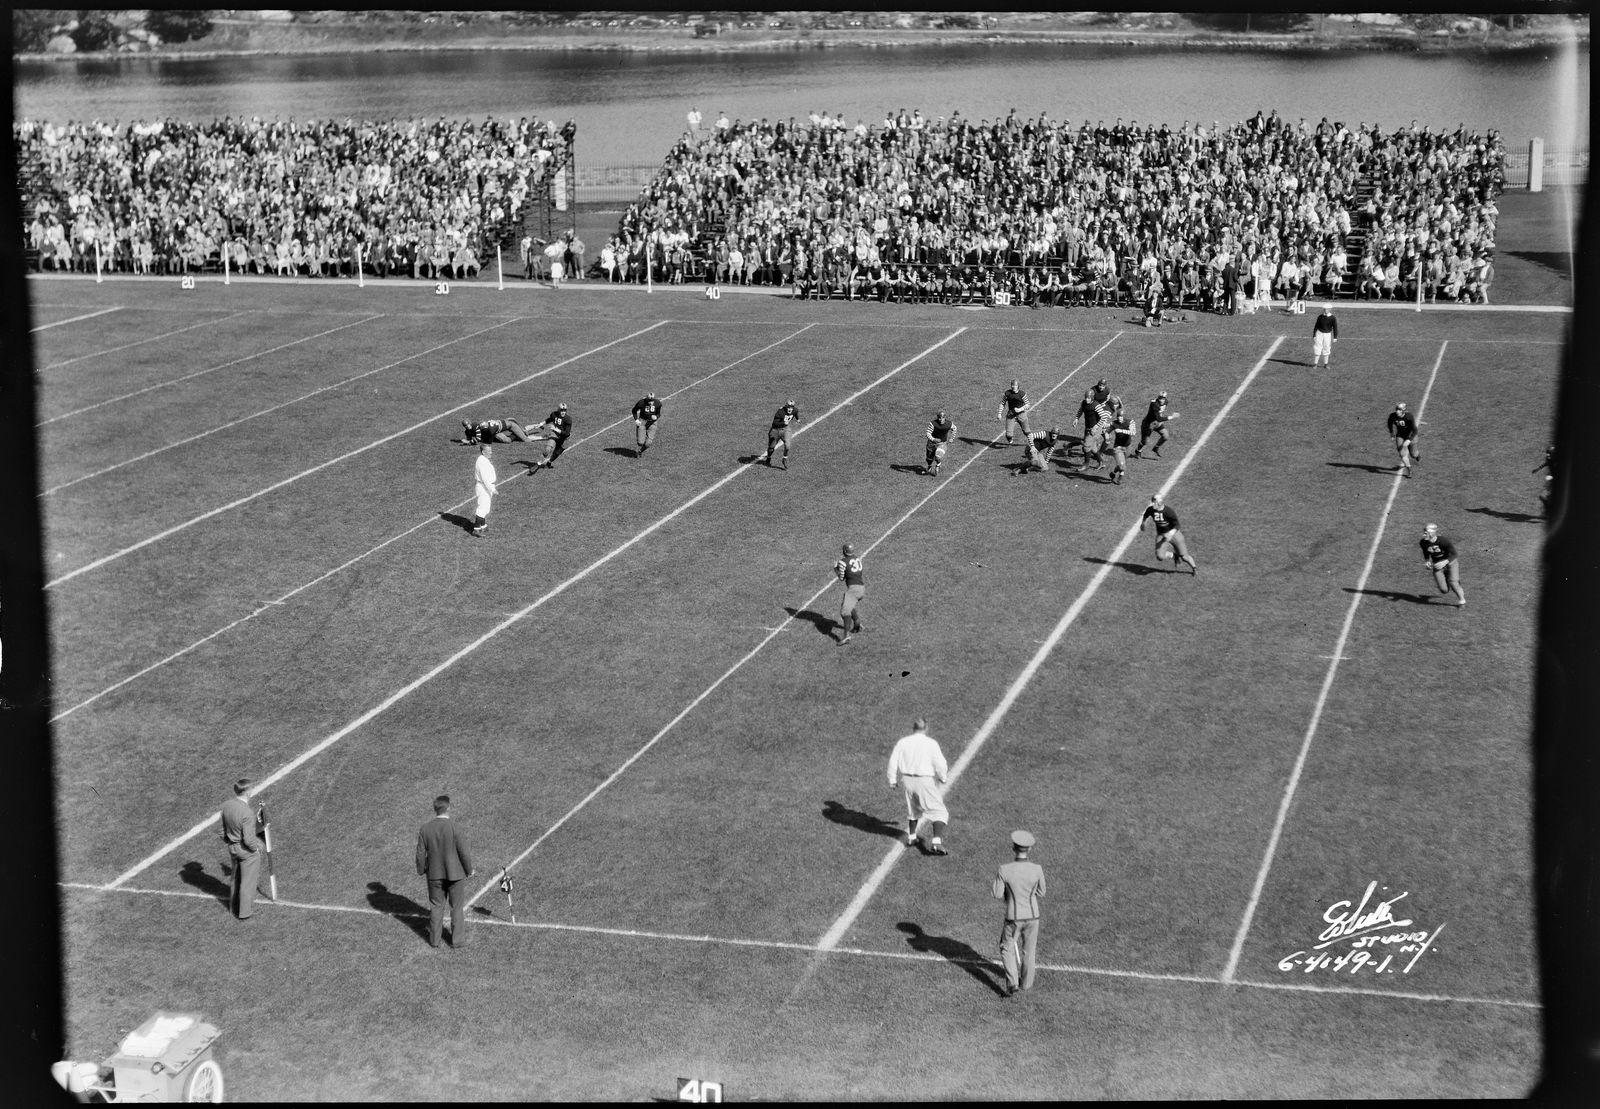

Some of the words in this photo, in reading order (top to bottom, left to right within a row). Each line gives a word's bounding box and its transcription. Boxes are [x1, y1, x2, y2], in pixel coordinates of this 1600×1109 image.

[182, 276, 195, 289] 20
[435, 282, 449, 295] 30
[705, 286, 720, 300] 40
[995, 291, 1010, 306] 50
[1288, 301, 1305, 314] 40
[1154, 512, 1164, 522] 21
[850, 556, 863, 573] 30
[501, 880, 512, 892] 41
[679, 1079, 721, 1104] 40
